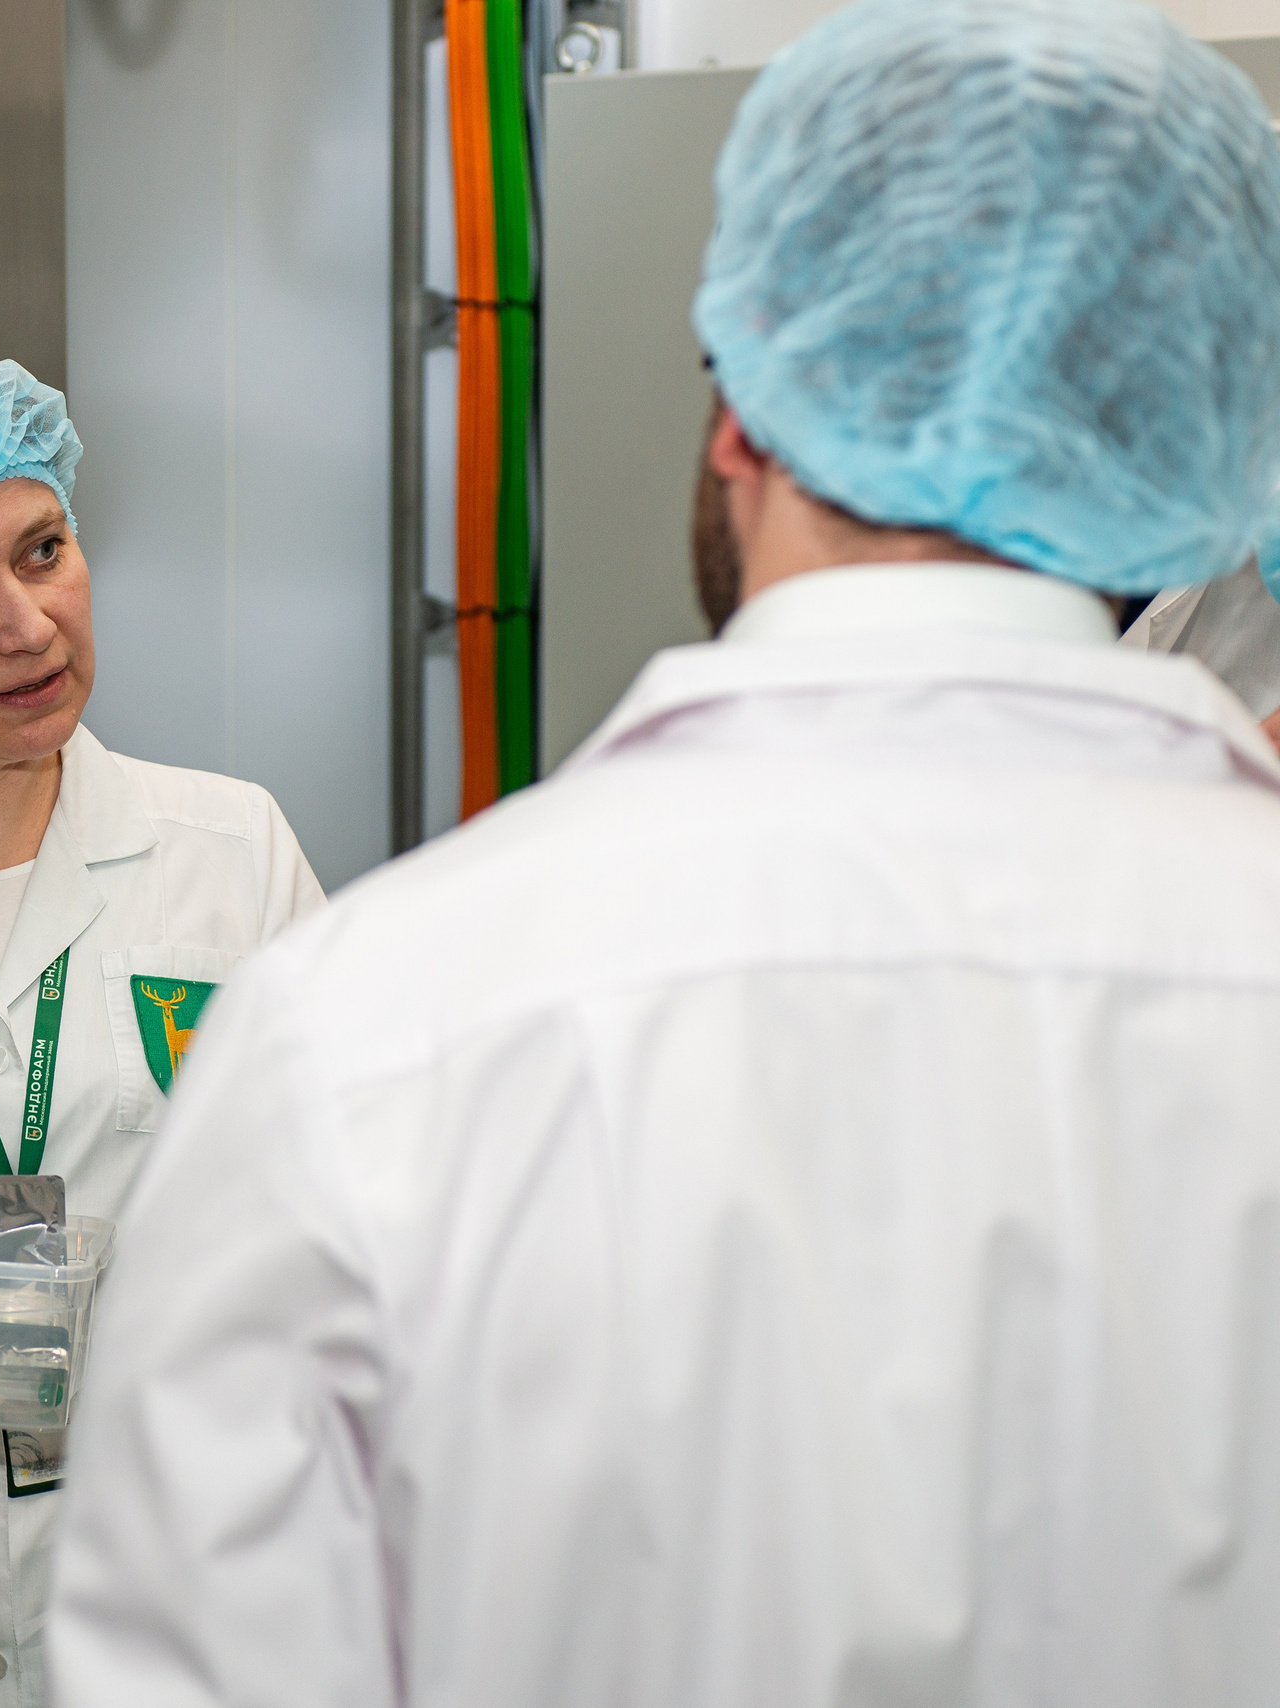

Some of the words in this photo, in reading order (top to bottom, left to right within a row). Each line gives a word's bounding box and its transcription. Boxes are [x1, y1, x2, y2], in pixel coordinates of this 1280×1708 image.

[27, 1039, 47, 1124] ЭНДОФАРМ
[39, 1092, 47, 1126] Московский
[43, 1055, 51, 1091] эндокринный
